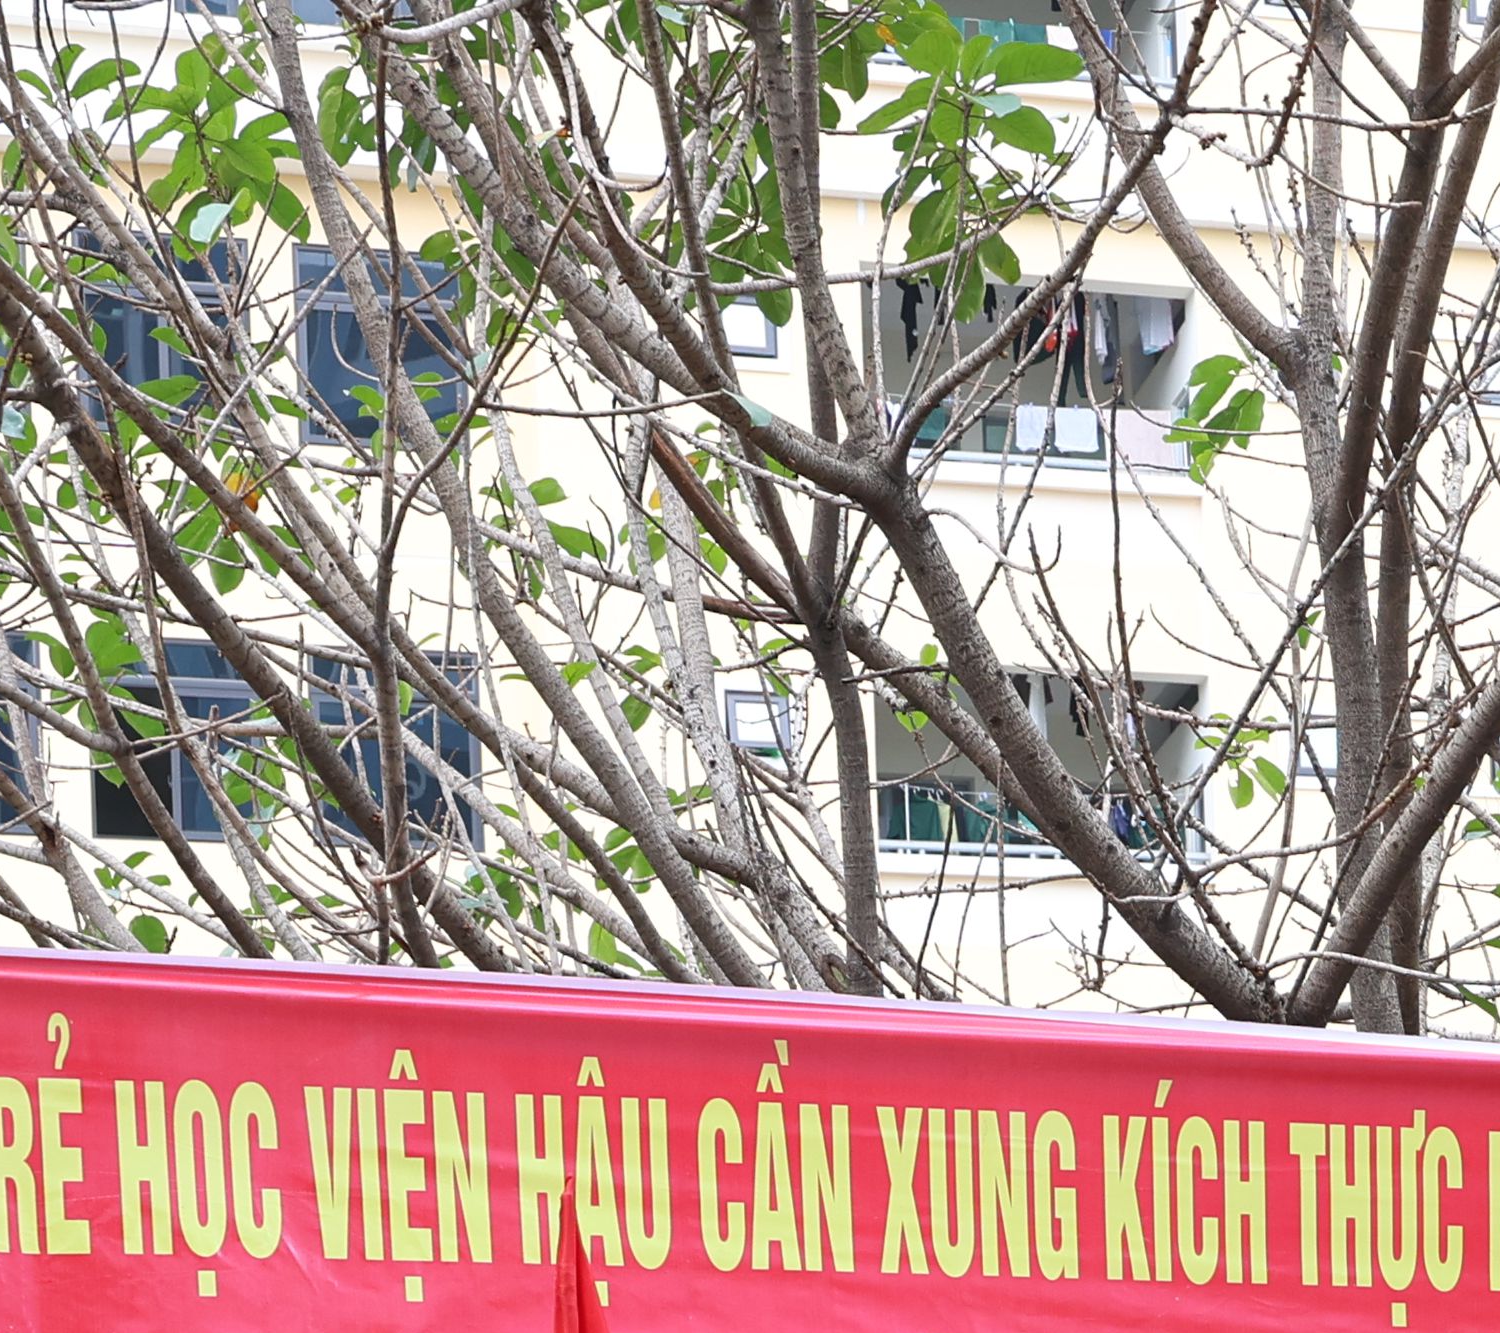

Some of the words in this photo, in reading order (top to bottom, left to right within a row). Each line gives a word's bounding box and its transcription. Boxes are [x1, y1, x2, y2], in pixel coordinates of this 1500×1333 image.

[116, 1080, 282, 1296] HỌC
[305, 1050, 492, 1300] VIỆN
[698, 1040, 854, 1271] CẦN
[877, 1107, 1079, 1279] XUNG
[1103, 1080, 1267, 1284] KÍCH
[1290, 1110, 1463, 1326] THỰC
